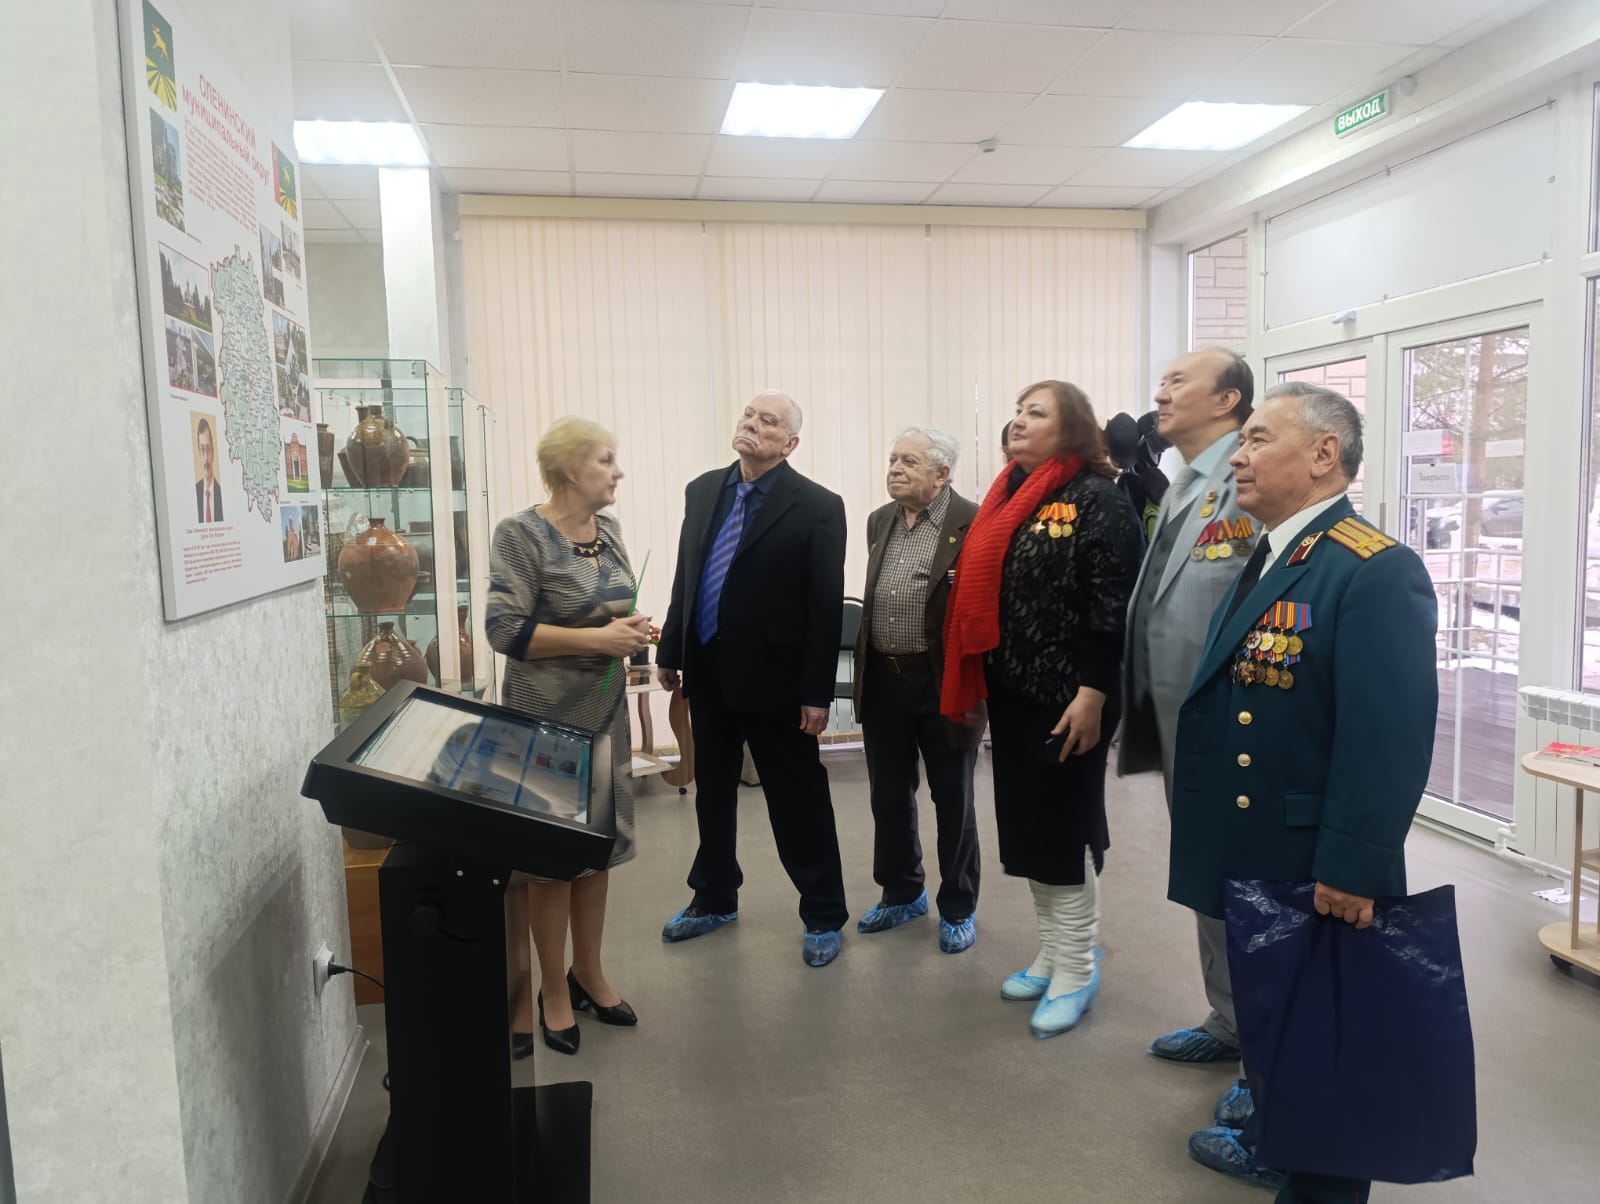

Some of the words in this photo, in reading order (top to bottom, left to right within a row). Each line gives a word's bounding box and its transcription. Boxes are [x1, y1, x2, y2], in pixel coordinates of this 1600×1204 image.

[182, 84, 251, 165] муниципальный
[251, 155, 270, 187] округ
[199, 73, 257, 151] ОЛЕНИНСКИЙ
[1338, 98, 1381, 130] ВЫХОД
